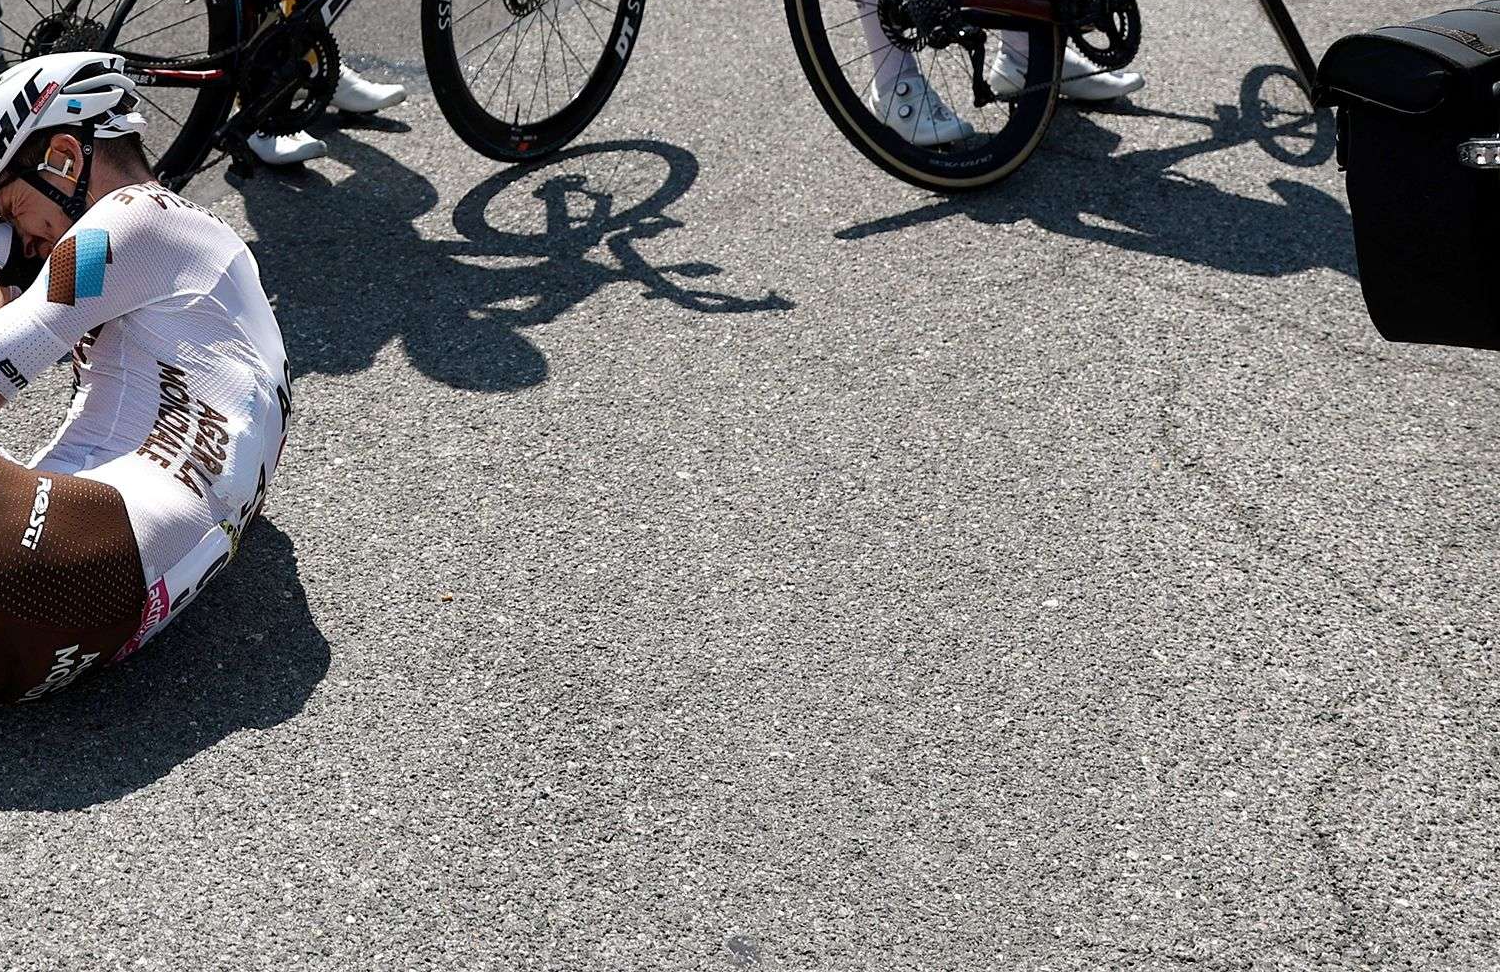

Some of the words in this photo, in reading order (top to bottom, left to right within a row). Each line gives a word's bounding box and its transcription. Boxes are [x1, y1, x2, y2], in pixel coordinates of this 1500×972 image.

[614, 17, 639, 62] DT
[135, 359, 192, 471] MONDIALE
[190, 398, 230, 476] AG2R
[172, 453, 214, 499] LA
